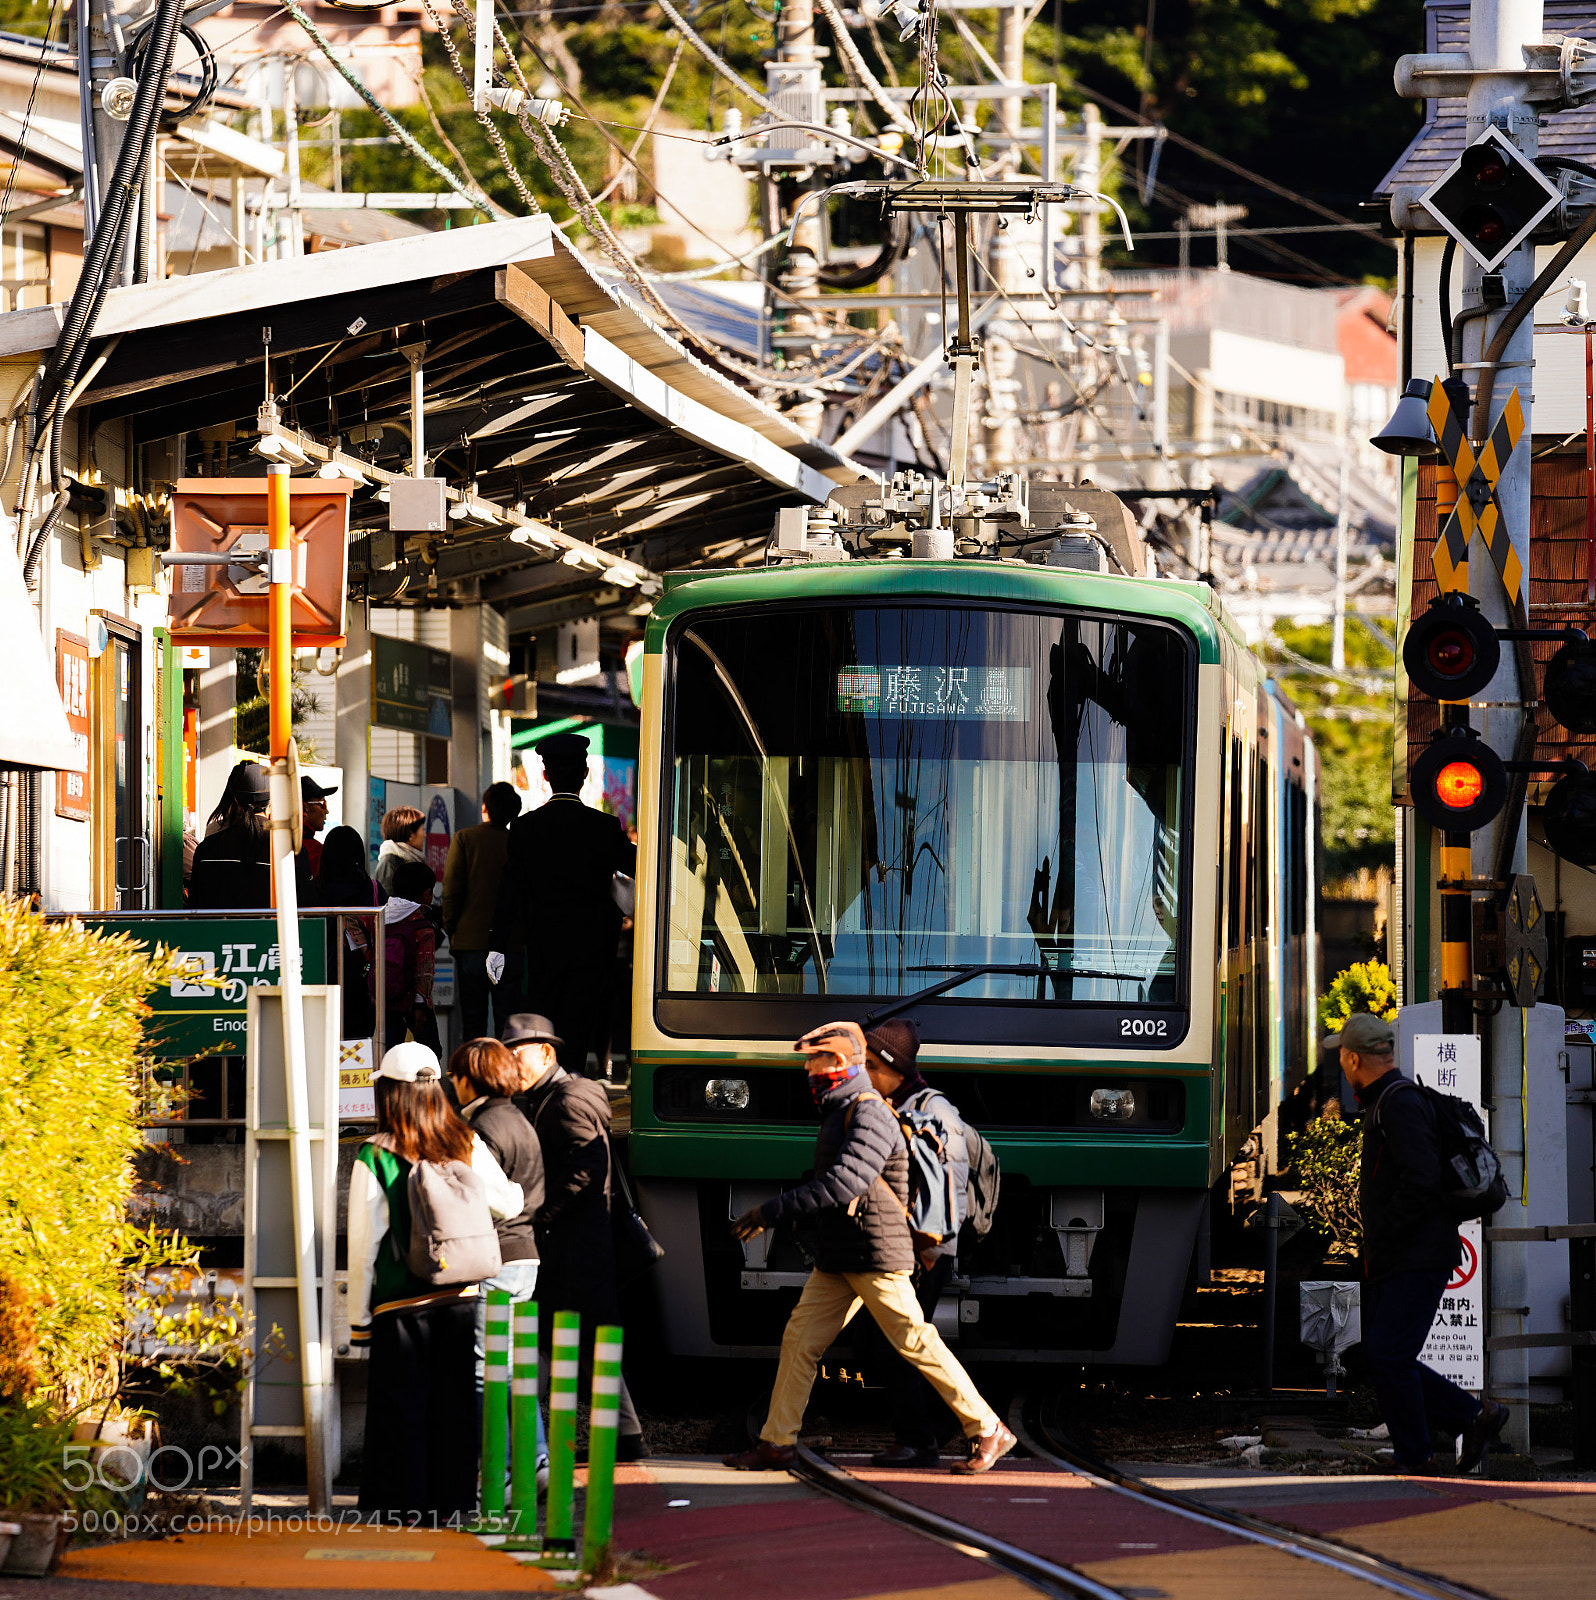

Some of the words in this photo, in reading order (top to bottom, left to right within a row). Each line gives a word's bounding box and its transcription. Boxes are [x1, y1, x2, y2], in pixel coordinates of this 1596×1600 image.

[885, 666, 969, 702] 藤沢
[889, 702, 965, 714] FUJISAWA
[719, 782, 732, 860] 乗務室
[1121, 1019, 1167, 1036] 2002
[1437, 1042, 1457, 1088] 横断
[1438, 1297, 1470, 1311] 路内
[1431, 1313, 1478, 1327] 入禁止
[1431, 1334, 1450, 1342] Keep
[1453, 1333, 1466, 1341] Out
